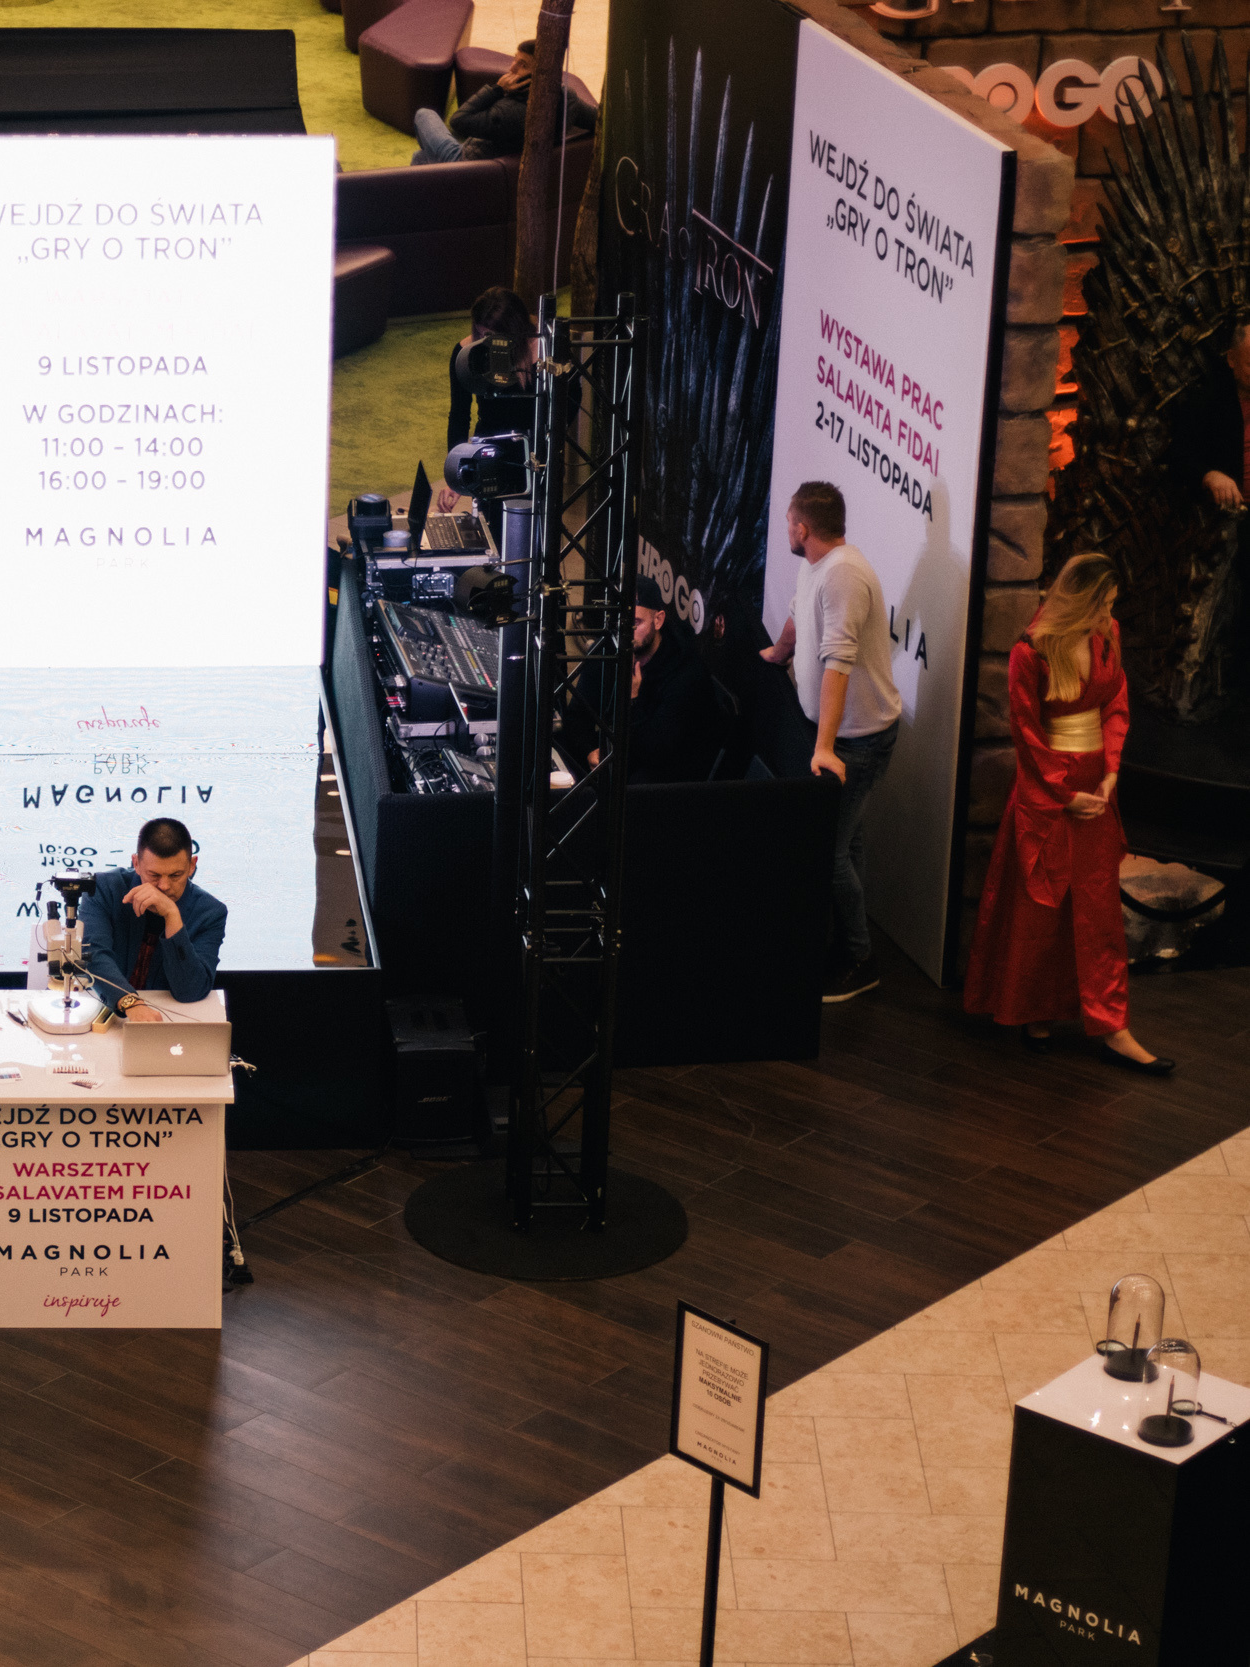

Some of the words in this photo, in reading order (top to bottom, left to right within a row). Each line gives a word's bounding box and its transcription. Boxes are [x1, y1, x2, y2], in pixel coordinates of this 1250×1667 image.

[95, 203, 138, 226] DO
[150, 197, 263, 226] ŚWIATA
[810, 129, 869, 201] WEJDŹ
[874, 176, 899, 220] DO
[905, 193, 974, 277] ŚWIATA
[102, 237, 124, 260] O
[616, 156, 674, 260] GRA
[678, 226, 690, 260] O
[692, 208, 773, 330] TRON
[875, 227, 888, 261] O
[38, 356, 52, 376] 9
[62, 356, 208, 376] LISTOPADA
[821, 309, 895, 394] WYSTAWA
[902, 373, 944, 430] PRAC
[22, 404, 47, 424] W
[58, 404, 224, 424] GODZINACH:
[817, 355, 892, 440] SALAVATA
[898, 418, 939, 477] FIDAI
[40, 437, 104, 458] 11:00
[135, 437, 204, 458] 14:00
[816, 401, 844, 443] 2-17
[848, 426, 933, 522] LISTOPADA
[38, 470, 106, 490] 16:00
[138, 470, 206, 490] 19:00
[26, 527, 218, 547] MAGNOLIA
[60, 1108, 97, 1125] DO
[106, 1103, 203, 1125] ŚWIATA
[62, 1130, 81, 1148] O
[12, 1162, 150, 1178] WARSZTATY
[132, 1184, 191, 1201] FIDAI
[8, 1207, 22, 1224] 9
[28, 1207, 154, 1224] LISTOPADA
[59, 1266, 108, 1277] PARK
[42, 1291, 122, 1318] inspiruje
[691, 1321, 723, 1342] SZANOWNI
[705, 1353, 730, 1371] STREFIE
[698, 1376, 742, 1403] MAKSYMALNIE
[696, 1441, 737, 1466] MAGNOLIA
[1014, 1582, 1142, 1646] MAGNOLIA
[1059, 1620, 1096, 1641] PARK
